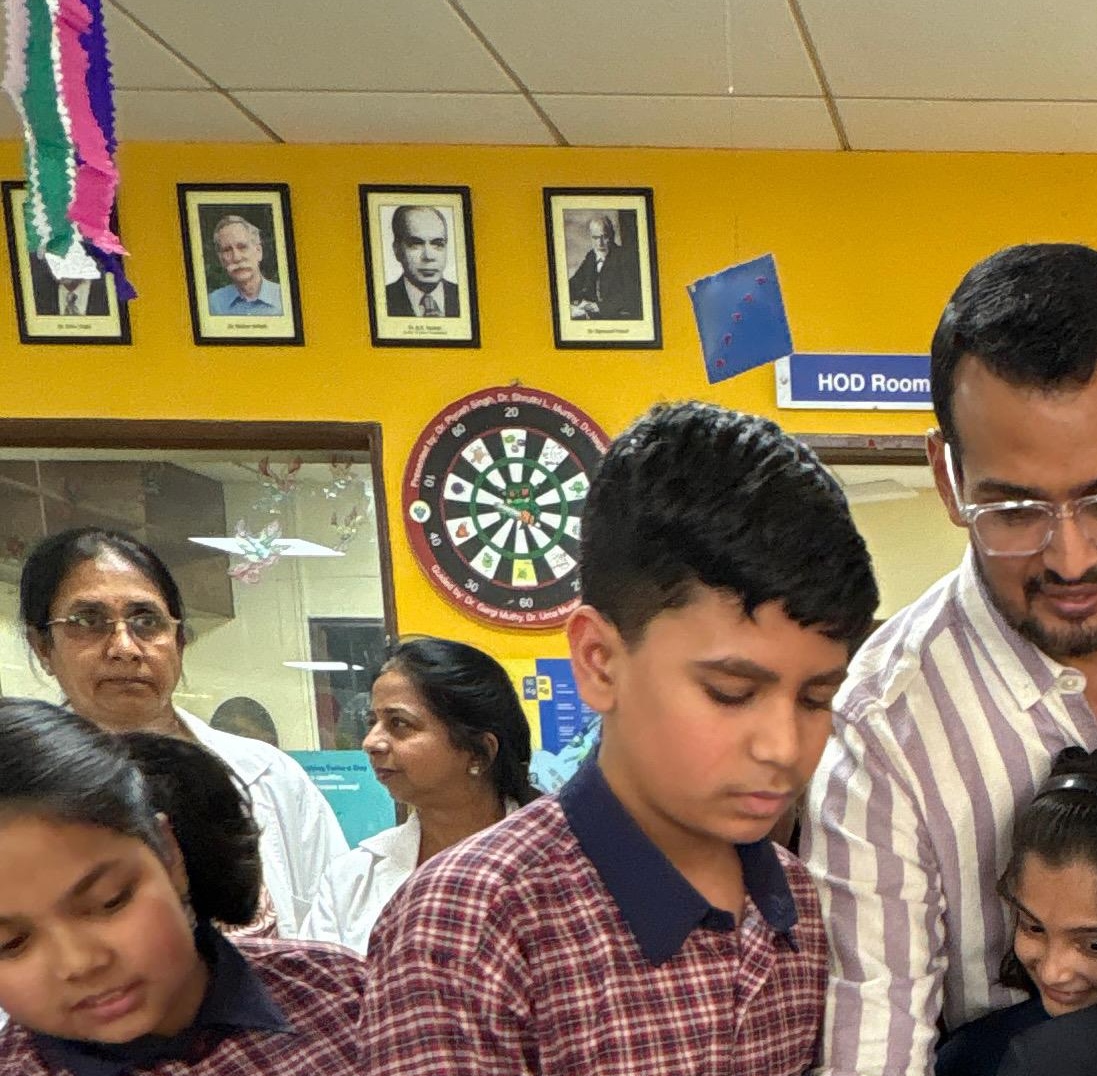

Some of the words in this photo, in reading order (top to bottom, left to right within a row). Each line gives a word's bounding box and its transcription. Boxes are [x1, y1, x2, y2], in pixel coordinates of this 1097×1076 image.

[817, 373, 865, 392] HOD
[871, 373, 931, 392] Room
[504, 406, 519, 418] 20
[429, 531, 442, 547] 40
[465, 578, 479, 592] 30
[519, 597, 534, 608] 60
